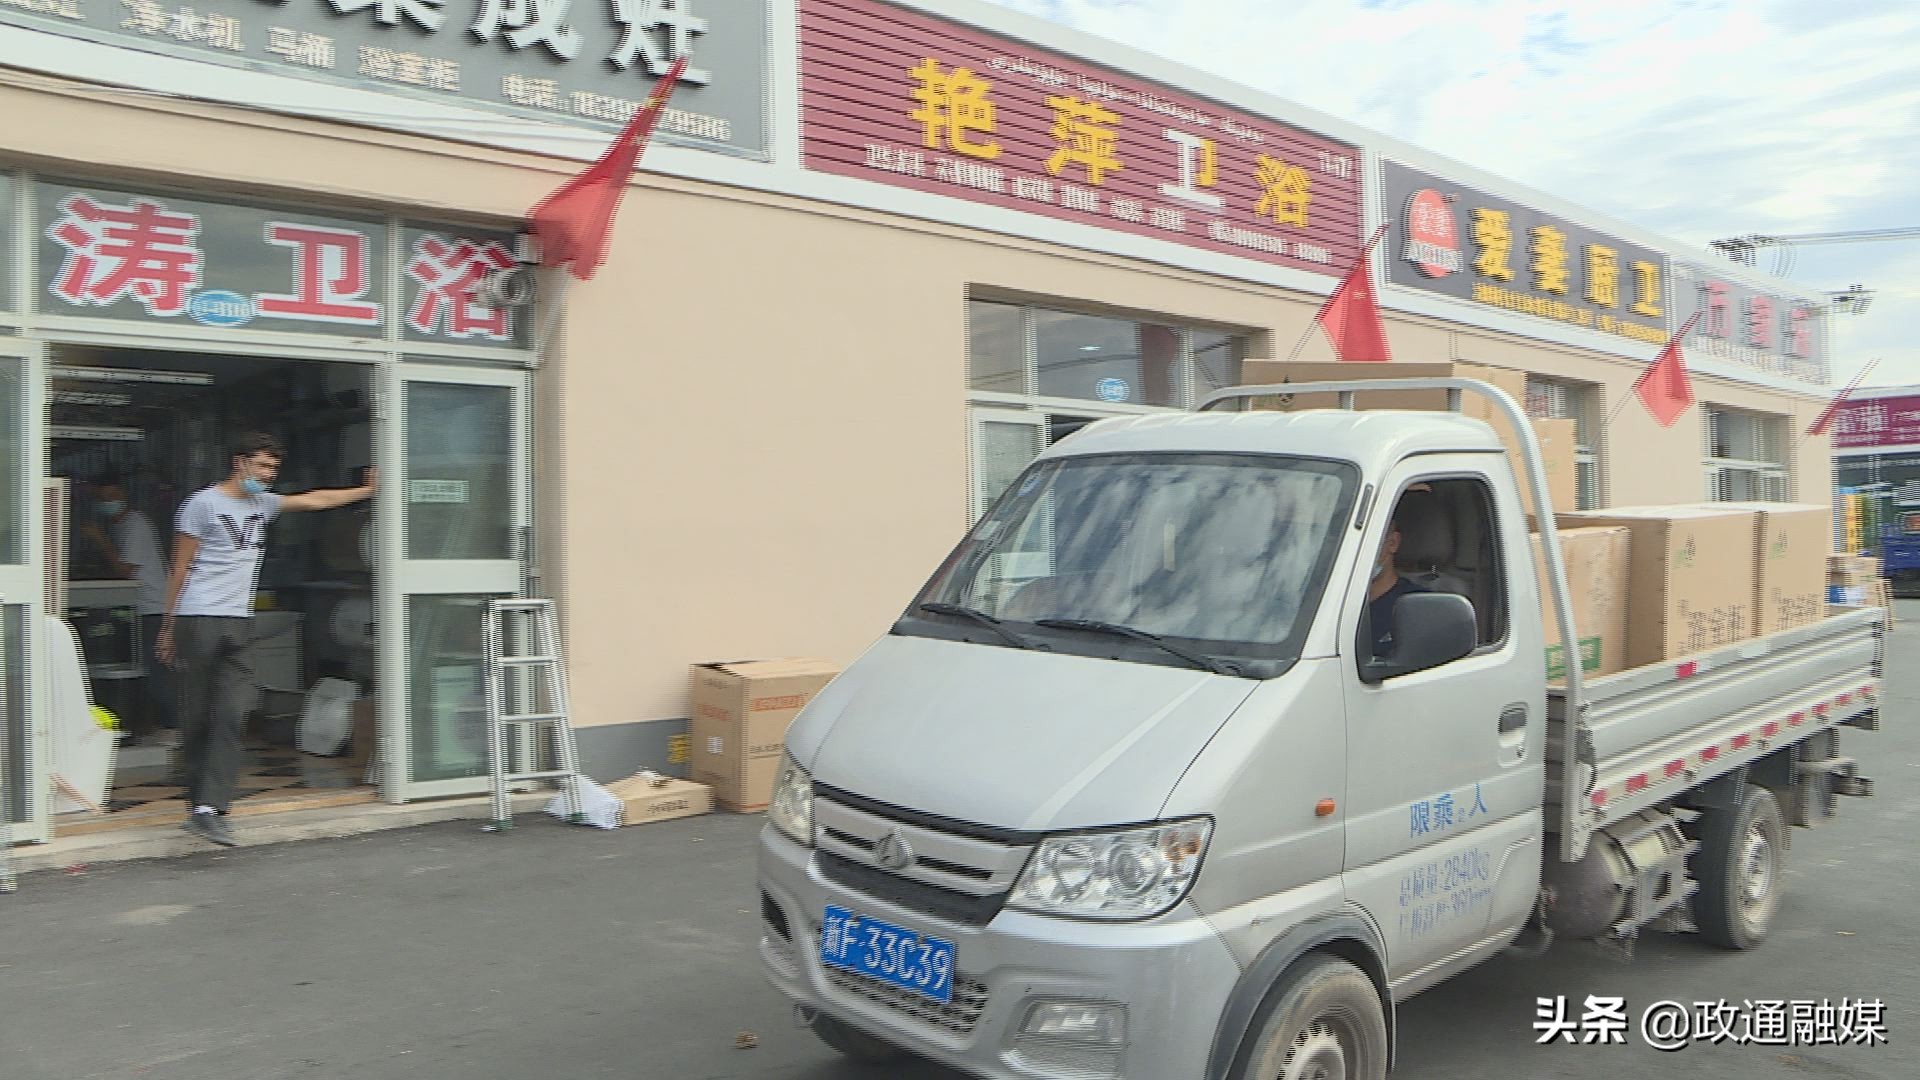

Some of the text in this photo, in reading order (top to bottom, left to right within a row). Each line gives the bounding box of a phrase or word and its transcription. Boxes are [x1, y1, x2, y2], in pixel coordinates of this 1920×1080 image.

[119, 0, 246, 51] 净水机
[264, 26, 337, 69] 马桶
[358, 45, 461, 92] 浴室柜
[501, 74, 732, 141] 电话:1839979586
[907, 57, 1312, 228] 艳萍卫浴
[863, 143, 926, 177] 卫生洁具
[1469, 206, 1664, 317] 爱妻厨卫
[1687, 603, 1746, 650] 浴室柜
